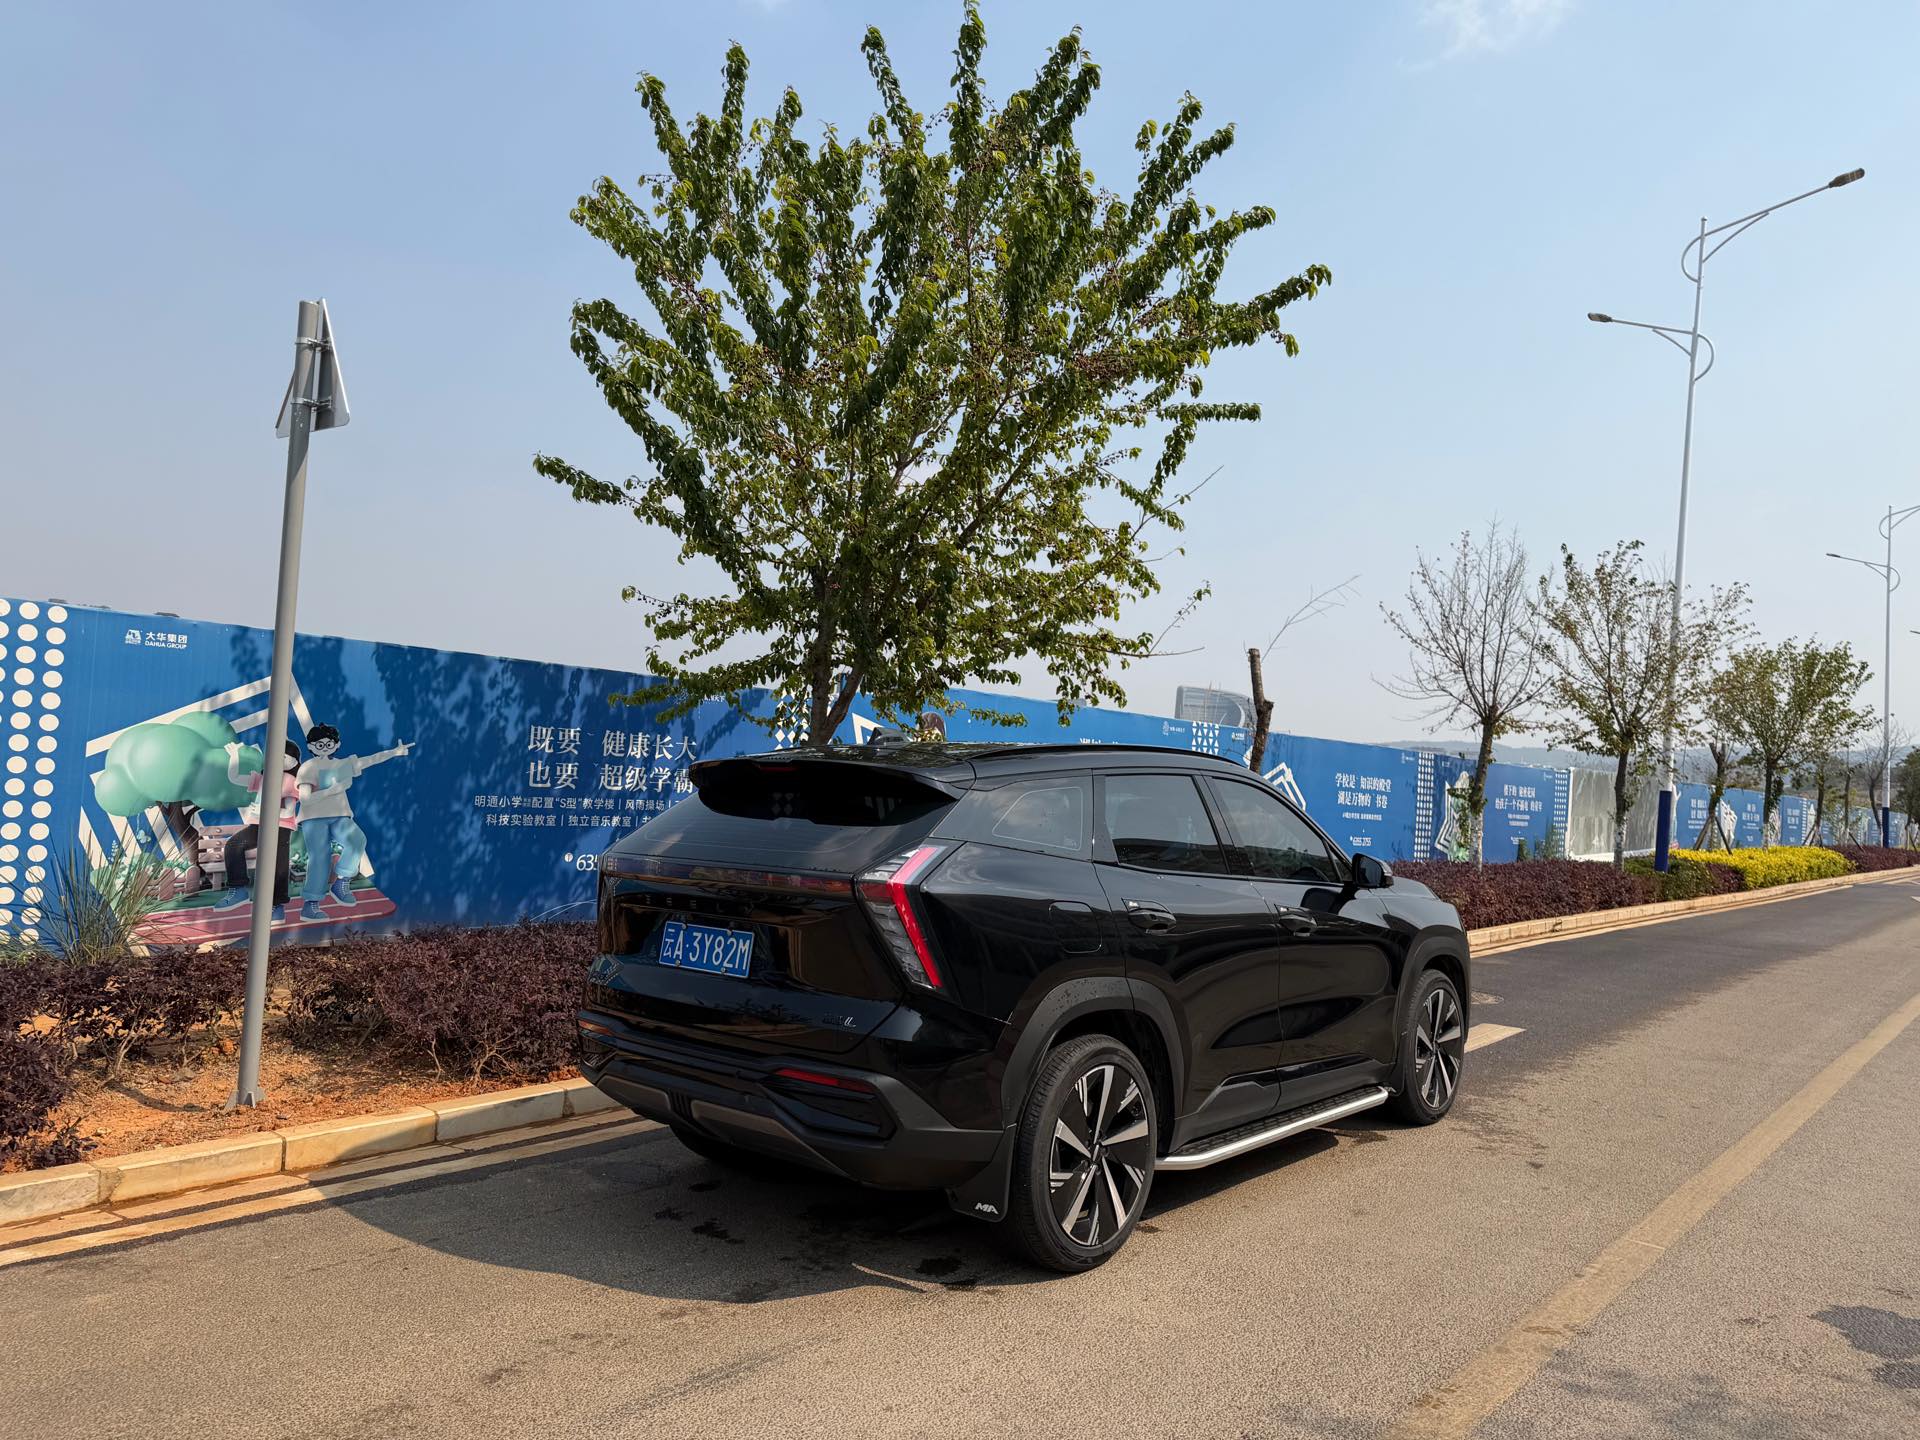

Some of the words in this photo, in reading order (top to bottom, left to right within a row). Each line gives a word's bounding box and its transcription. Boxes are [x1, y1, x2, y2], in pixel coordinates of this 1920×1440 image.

[146, 632, 188, 643] 大华集团
[166, 642, 187, 650] GROUP
[528, 725, 582, 755] 既要
[602, 729, 698, 761] 健康长大
[526, 760, 580, 790] 也要
[600, 763, 694, 794] 超级学霸
[1335, 772, 1357, 789] 学校是
[474, 795, 523, 808] 明通小学
[624, 799, 665, 811] 风雨操场
[485, 813, 557, 827] 科技实验教室
[567, 814, 632, 828] 独立音乐教室
